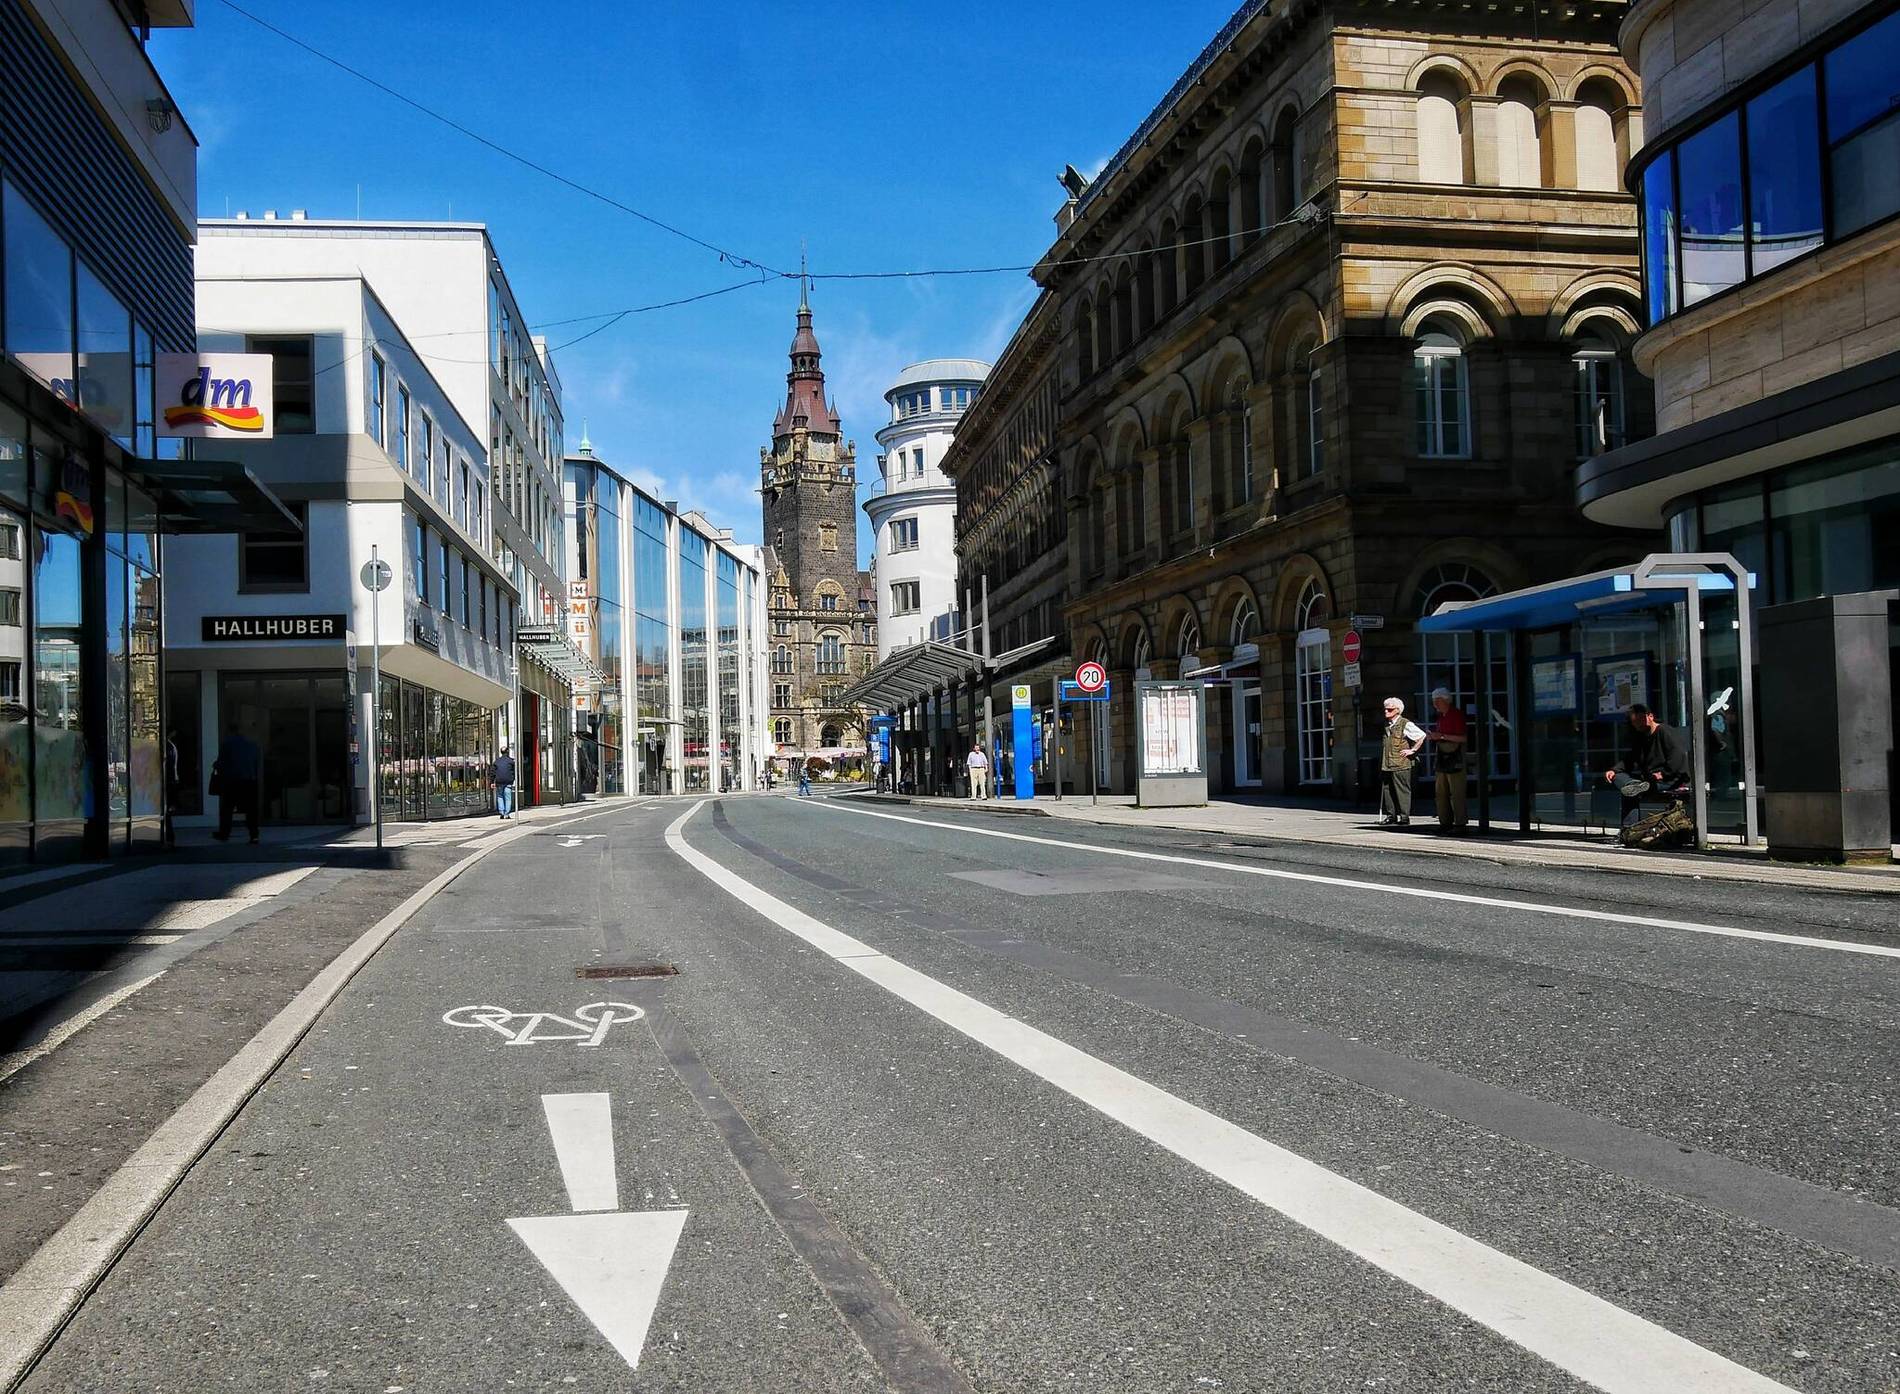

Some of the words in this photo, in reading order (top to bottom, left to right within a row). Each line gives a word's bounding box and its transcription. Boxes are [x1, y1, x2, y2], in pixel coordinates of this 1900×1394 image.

[181, 366, 252, 408] dm
[214, 619, 334, 635] HALLHUBER
[1083, 670, 1099, 684] 20
